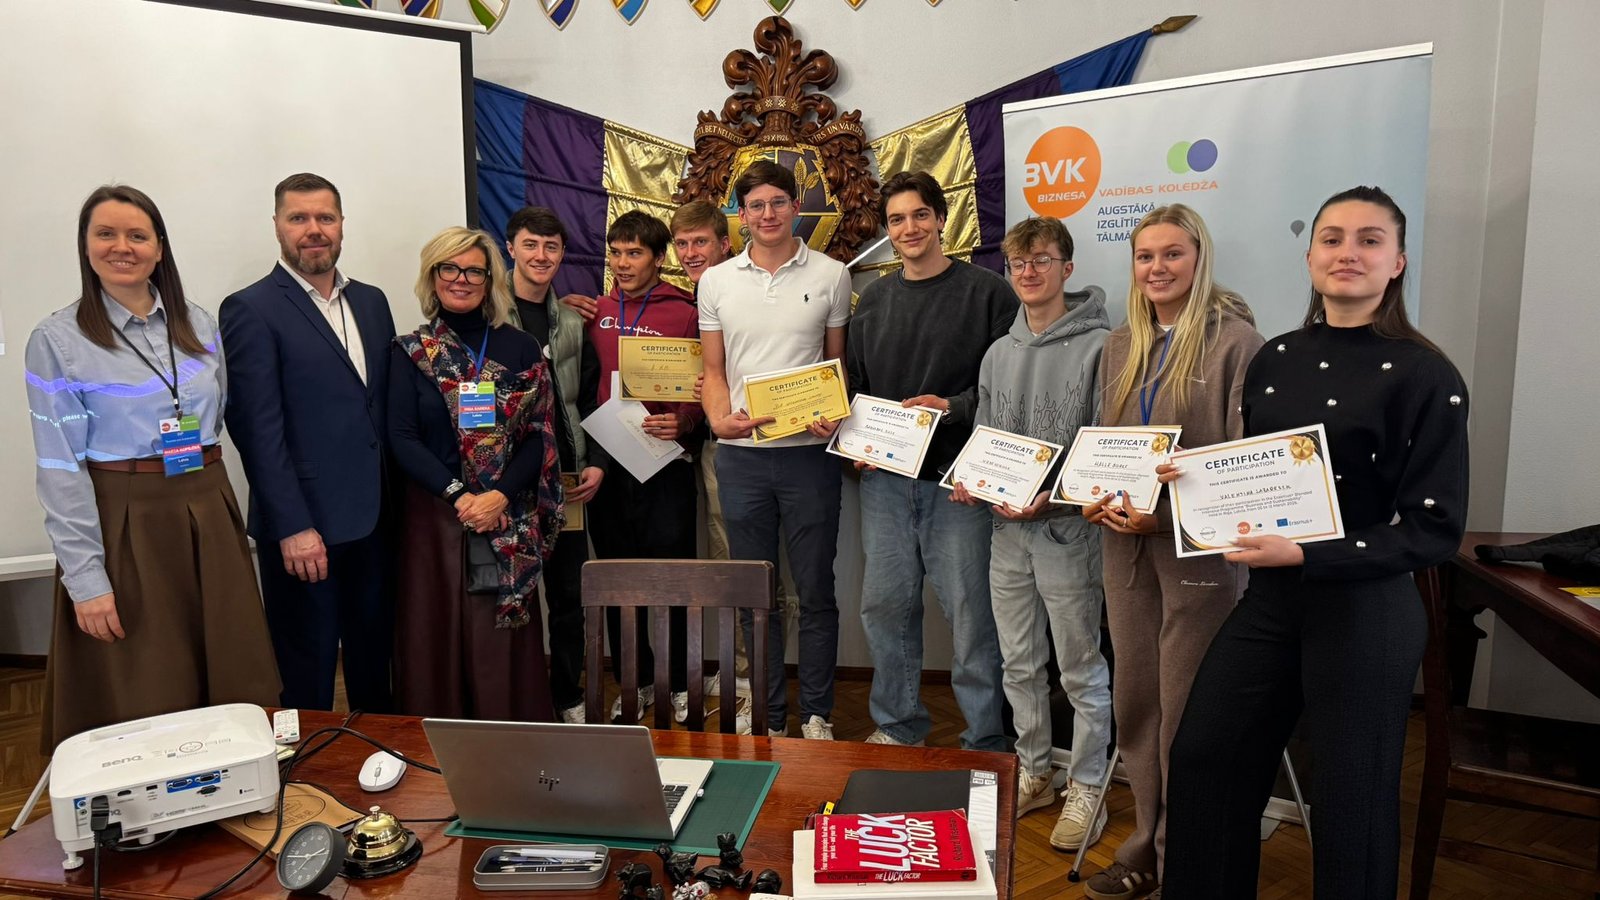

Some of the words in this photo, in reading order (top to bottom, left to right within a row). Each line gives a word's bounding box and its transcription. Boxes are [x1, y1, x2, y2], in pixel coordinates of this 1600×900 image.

[704, 125, 717, 133] BET
[827, 124, 838, 135] UN
[1023, 157, 1087, 188] BVK
[1037, 191, 1087, 203] BIZNESA
[1099, 185, 1153, 198] VADĪBAS
[1096, 218, 1142, 229] IZGLĪTĪB
[1096, 232, 1131, 242] TĀLMĀ
[769, 376, 817, 391] CERTIFICATE
[871, 406, 915, 419] CERTIFICATE
[989, 438, 1034, 454] CERTIFICATE
[1097, 438, 1149, 446] CERTIFICATE
[1205, 448, 1284, 470] CERTIFICATE
[1227, 459, 1274, 473] PARTICIPATION
[1220, 477, 1248, 485] CERTIFICATE
[1288, 517, 1312, 526] Erasmus+
[845, 828, 859, 840] THE
[858, 814, 911, 871] LUCK
[905, 818, 940, 868] FACTOR
[884, 870, 904, 882] LUCK
[904, 872, 921, 880] FACTOR
